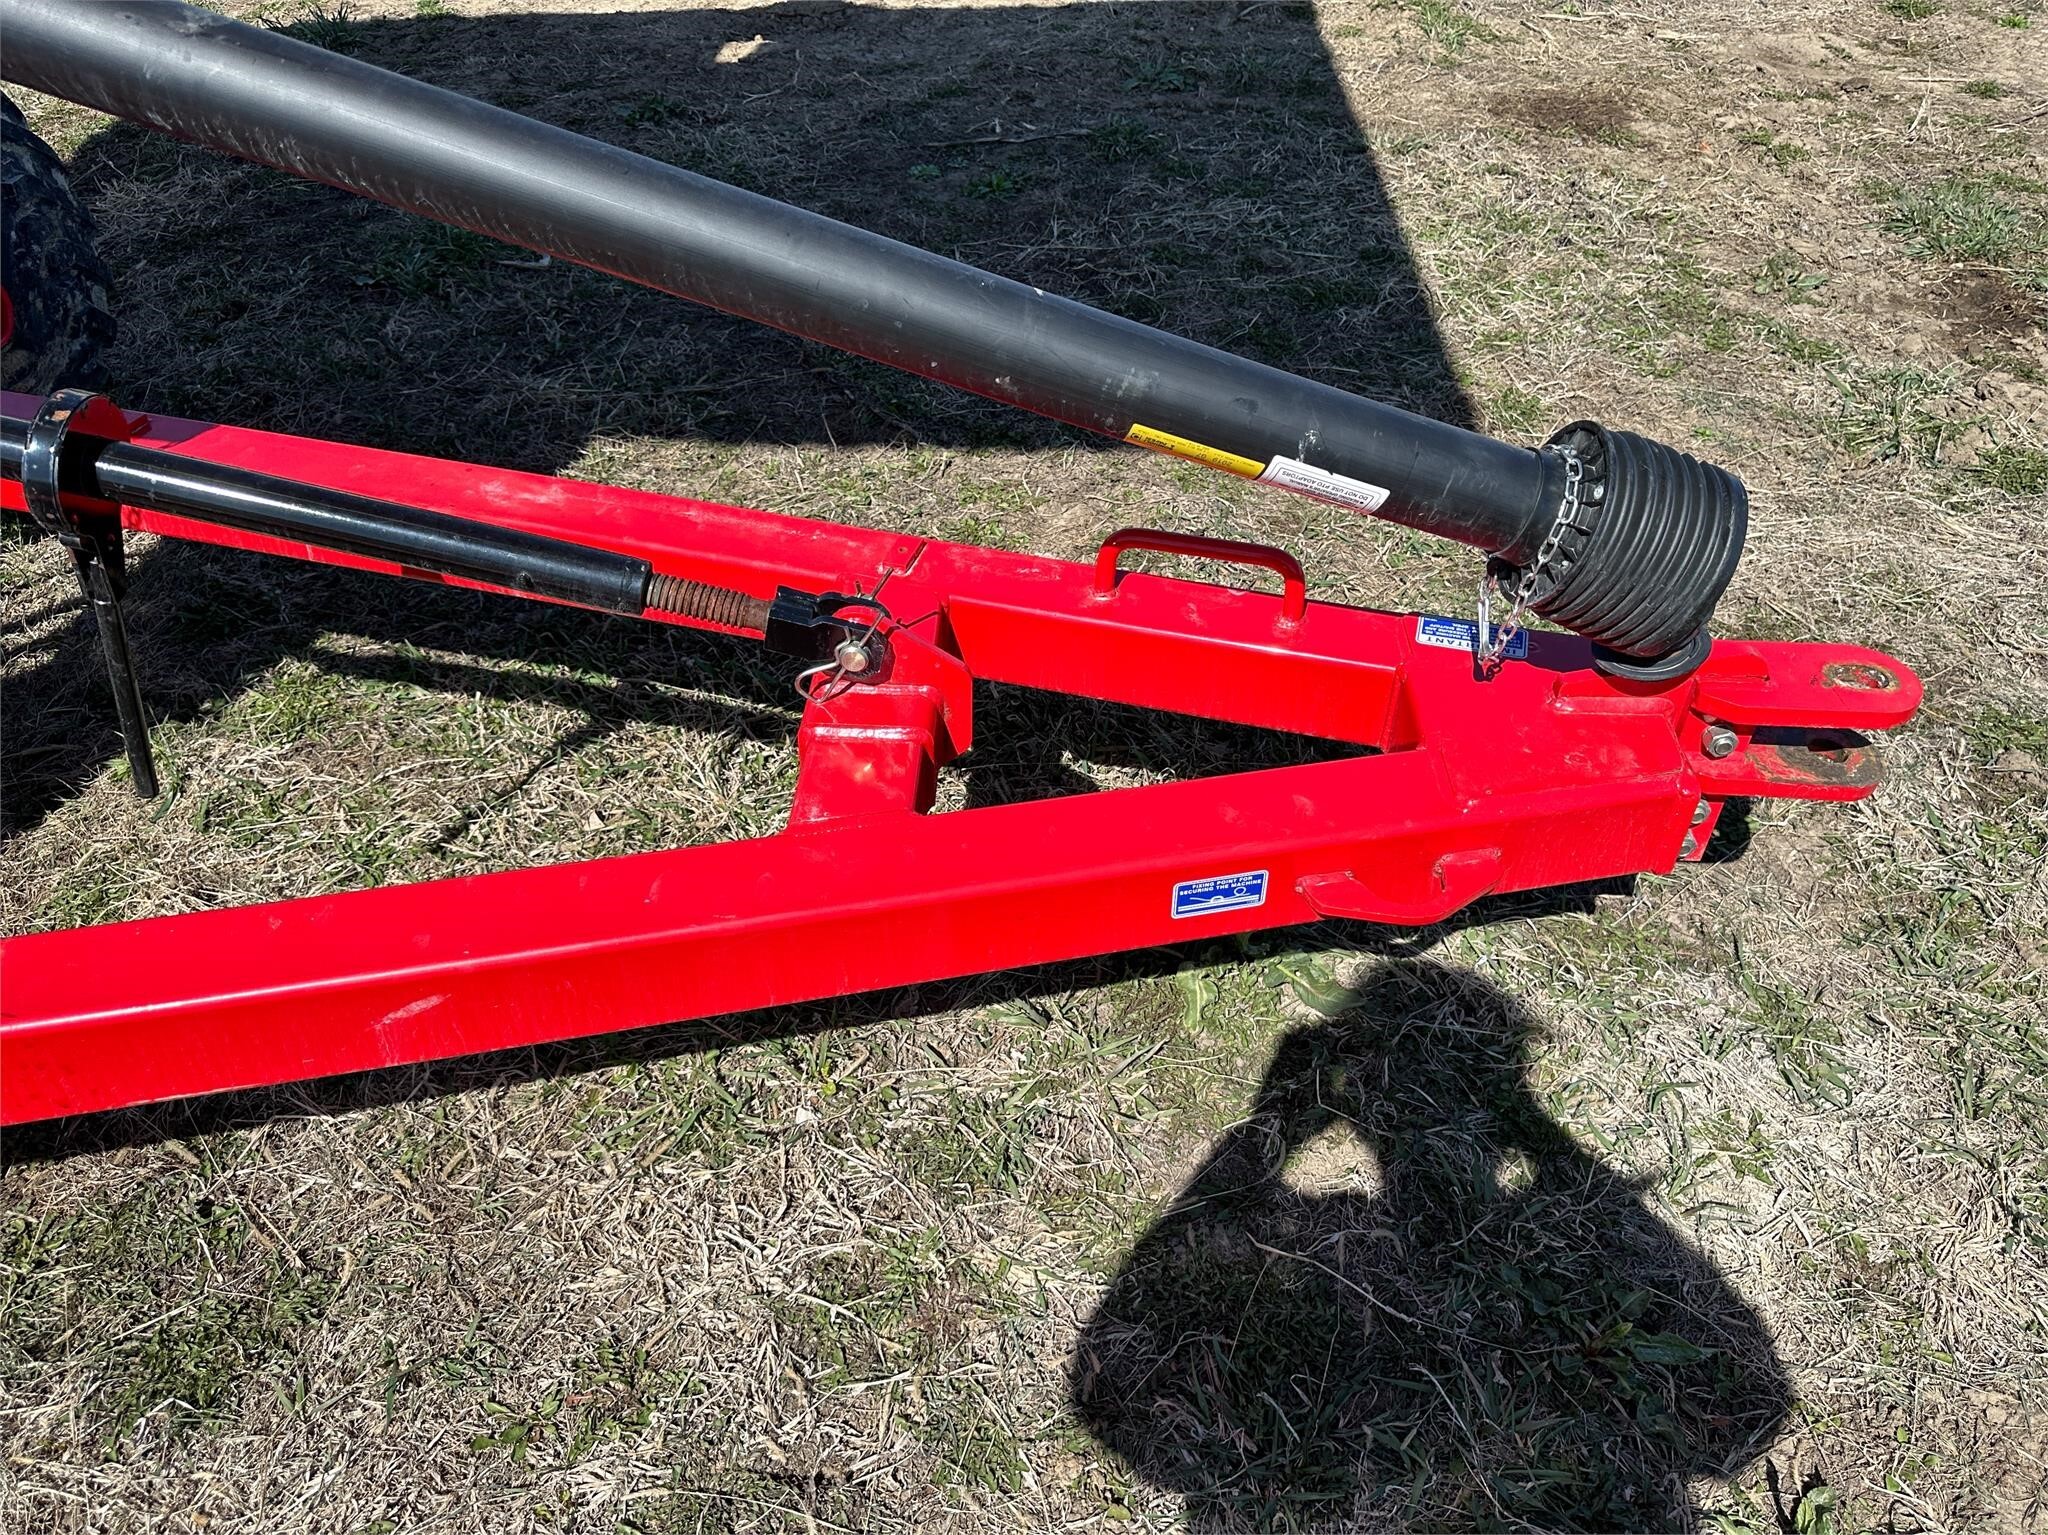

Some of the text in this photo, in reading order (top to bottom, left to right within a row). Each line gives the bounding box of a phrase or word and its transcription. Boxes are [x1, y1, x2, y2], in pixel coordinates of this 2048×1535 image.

[1281, 470, 1316, 486] ADAPTORS
[1316, 481, 1331, 490] PTO
[1331, 485, 1344, 494] USE
[1344, 490, 1357, 498] NOT
[1179, 886, 1214, 896] SECURING
[1231, 879, 1262, 888] MACHINE
[1192, 881, 1215, 889] FIXING
